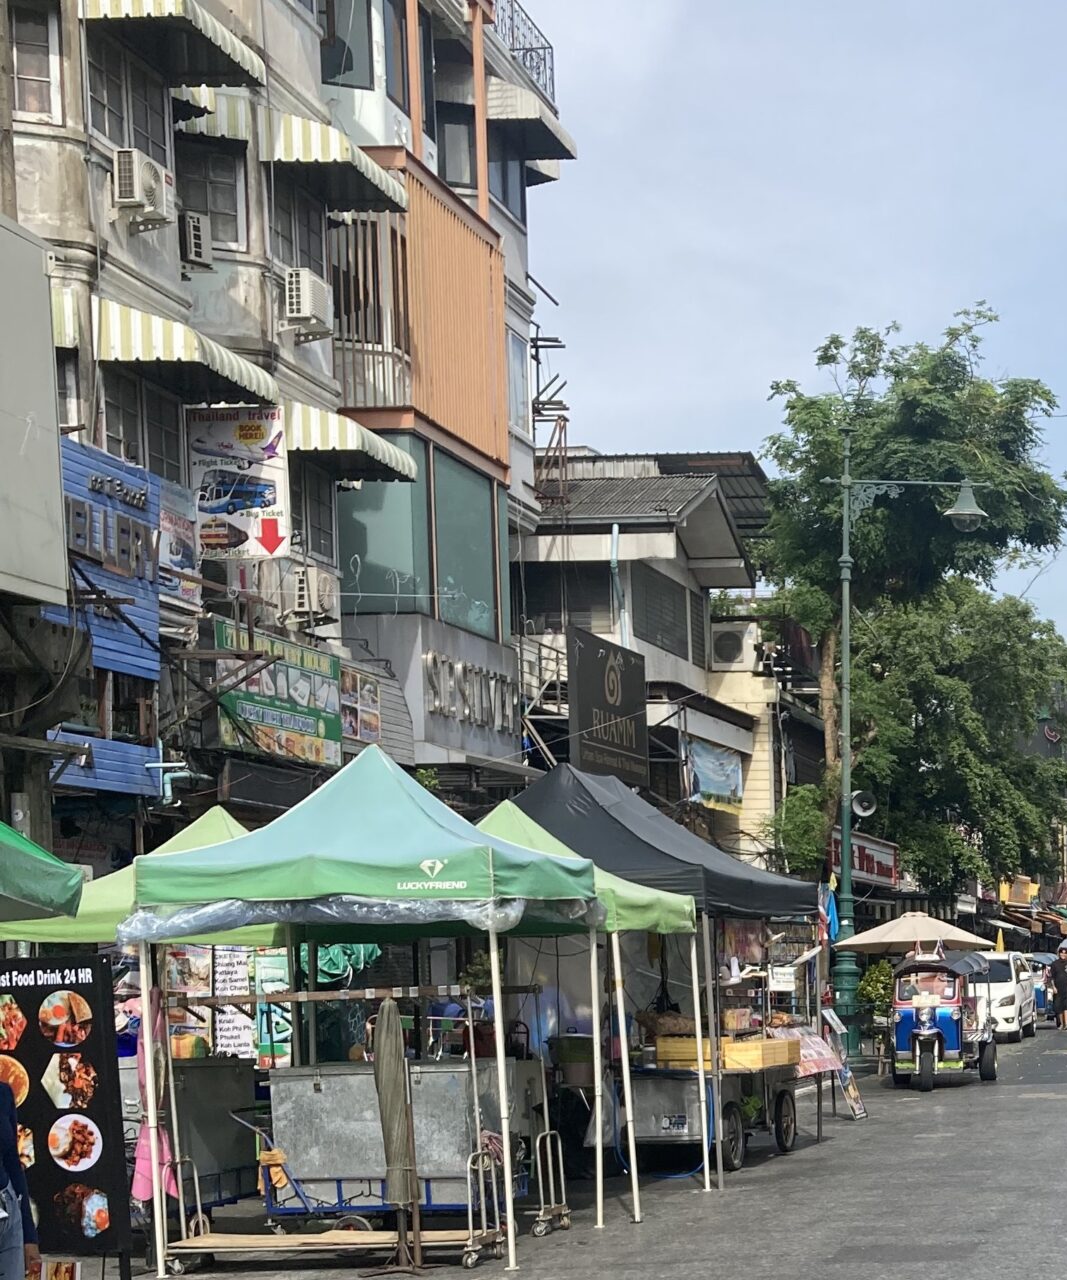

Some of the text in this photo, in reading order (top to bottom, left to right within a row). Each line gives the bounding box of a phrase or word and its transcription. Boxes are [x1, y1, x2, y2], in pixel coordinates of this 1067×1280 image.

[192, 409, 281, 421] Thailand travel
[239, 424, 262, 432] BOOK
[198, 459, 218, 467] Flight
[592, 708, 636, 749] RUAMM
[396, 880, 468, 890] LUCKYFRIEND
[12, 970, 34, 986] Food
[37, 969, 62, 986] Drink
[64, 968, 76, 984] 24
[78, 967, 93, 983] HR
